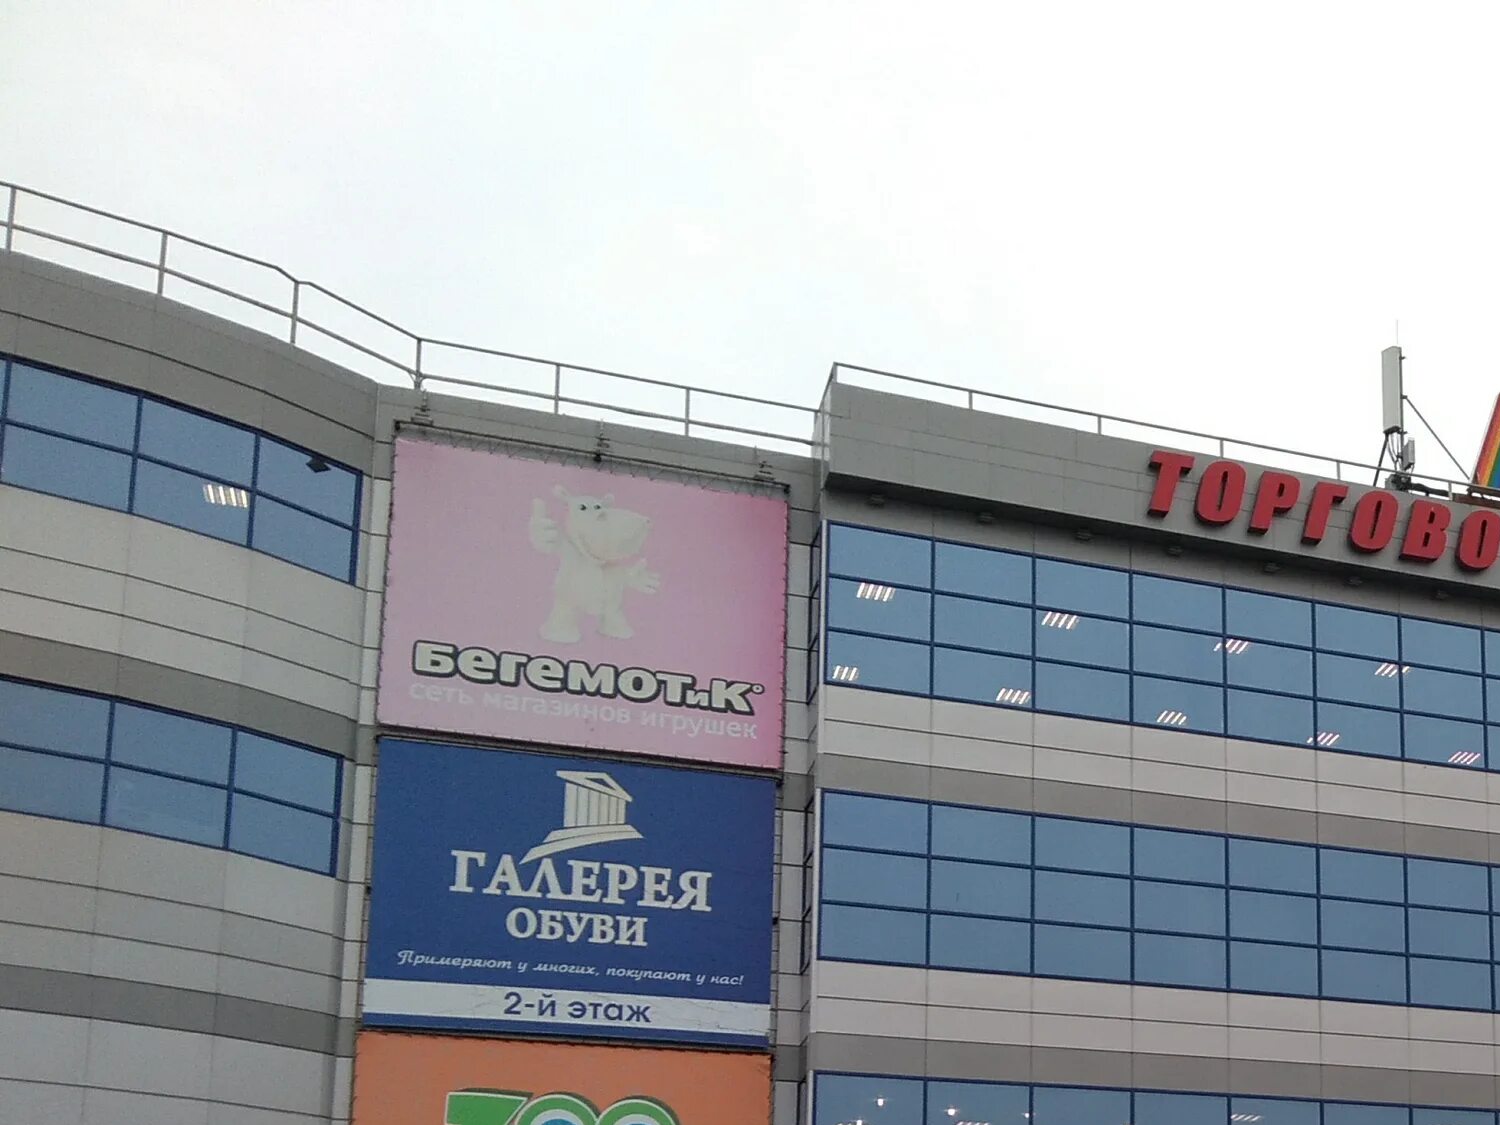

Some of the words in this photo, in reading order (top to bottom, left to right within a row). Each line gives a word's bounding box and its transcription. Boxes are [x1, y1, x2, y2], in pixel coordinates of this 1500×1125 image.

[409, 682, 468, 704] сеть
[483, 690, 631, 724] магазинов
[640, 709, 756, 740] игрушек
[449, 850, 712, 912] ГАЛЕРЕЯ
[505, 907, 648, 946] ОБУВИ
[397, 950, 512, 970] Примеряют
[517, 962, 528, 973] у
[532, 961, 600, 976] многих,
[606, 966, 691, 981] покупают
[696, 973, 706, 985] у
[711, 974, 744, 986] нас!
[504, 992, 556, 1016] 2-й
[568, 1001, 651, 1023] этаж
